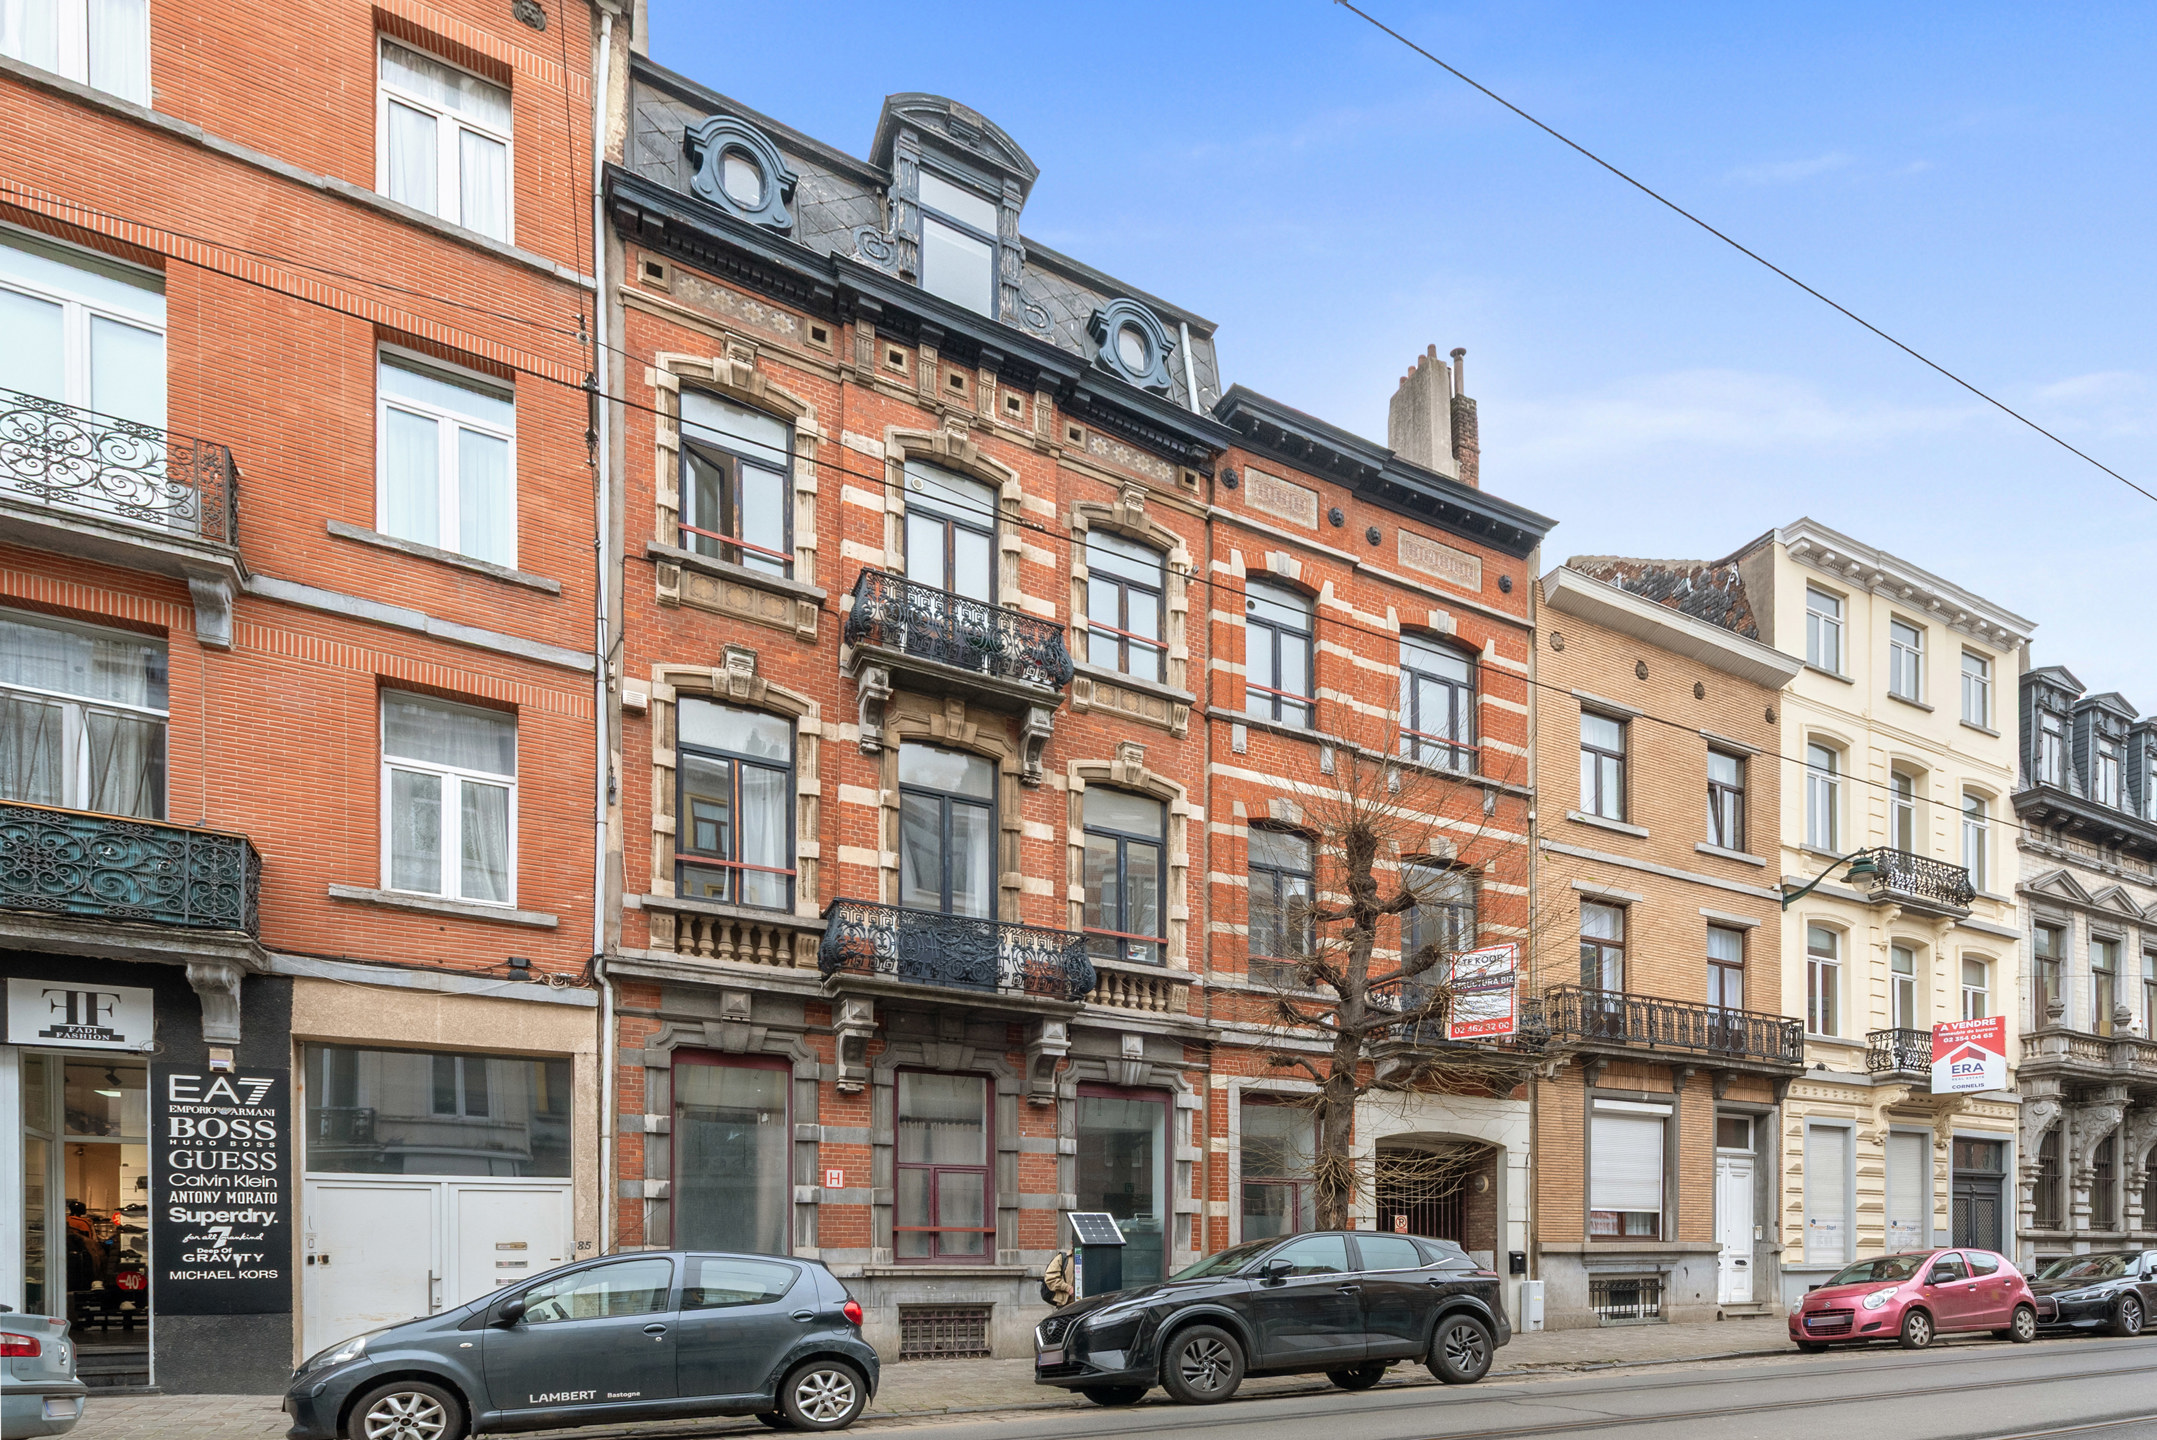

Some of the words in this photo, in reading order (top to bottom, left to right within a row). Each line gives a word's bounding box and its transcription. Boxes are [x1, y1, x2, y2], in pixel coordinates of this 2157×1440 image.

[1501, 975, 1514, 985] BIZ
[1454, 1026, 1465, 1034] 02
[1468, 1024, 1483, 1032] 462
[1498, 1021, 1510, 1029] 00
[1951, 1018, 1996, 1029] VENDRE
[55, 1032, 110, 1040] FASHION
[68, 1026, 97, 1034] FADI
[1951, 1062, 1984, 1074] ERA
[169, 1074, 275, 1105] EA7
[1951, 1082, 1985, 1090] CORNELIS
[169, 1105, 217, 1114] EMPORIO
[230, 1108, 276, 1117] ARMANI
[168, 1116, 277, 1141] BOSS
[169, 1139, 217, 1147] HUGO
[168, 1149, 277, 1171] GUESS
[168, 1172, 231, 1187] Calvin
[234, 1174, 278, 1188] Klein
[829, 1172, 840, 1185] H
[169, 1191, 221, 1204] ANTONY
[226, 1191, 278, 1204] MORATO
[169, 1206, 279, 1227] Superdry.
[182, 1233, 201, 1243] for
[202, 1233, 218, 1241] all
[196, 1247, 220, 1255] Deep
[577, 1241, 592, 1250] 85
[169, 1270, 236, 1280] MICHAEL
[239, 1269, 279, 1279] KORS
[529, 1390, 597, 1404] LAMBERT
[607, 1391, 641, 1399] Bastogne
